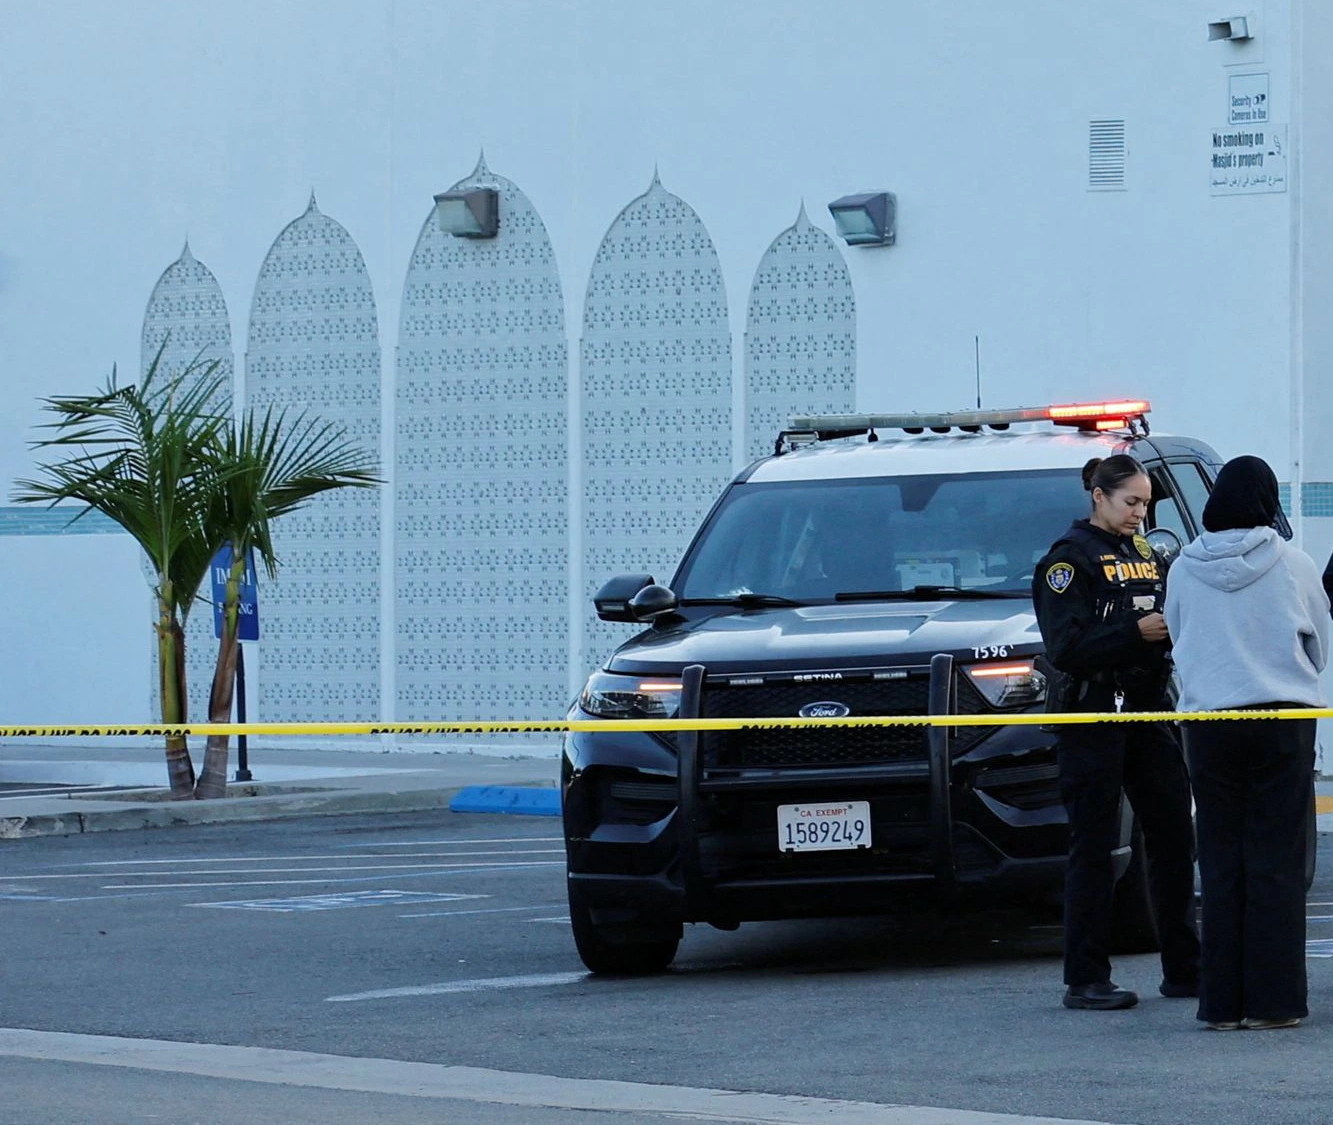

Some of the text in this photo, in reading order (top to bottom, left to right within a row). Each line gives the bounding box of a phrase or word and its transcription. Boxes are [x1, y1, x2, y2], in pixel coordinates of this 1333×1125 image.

[1212, 133, 1221, 148] No
[1223, 131, 1253, 148] smoking
[1103, 561, 1160, 582] POLICE
[971, 644, 1008, 659] 7596
[793, 672, 843, 683] SETINA
[810, 707, 837, 717] Ford
[800, 808, 848, 818] CA EXEMPT
[786, 820, 864, 845] 1589249
